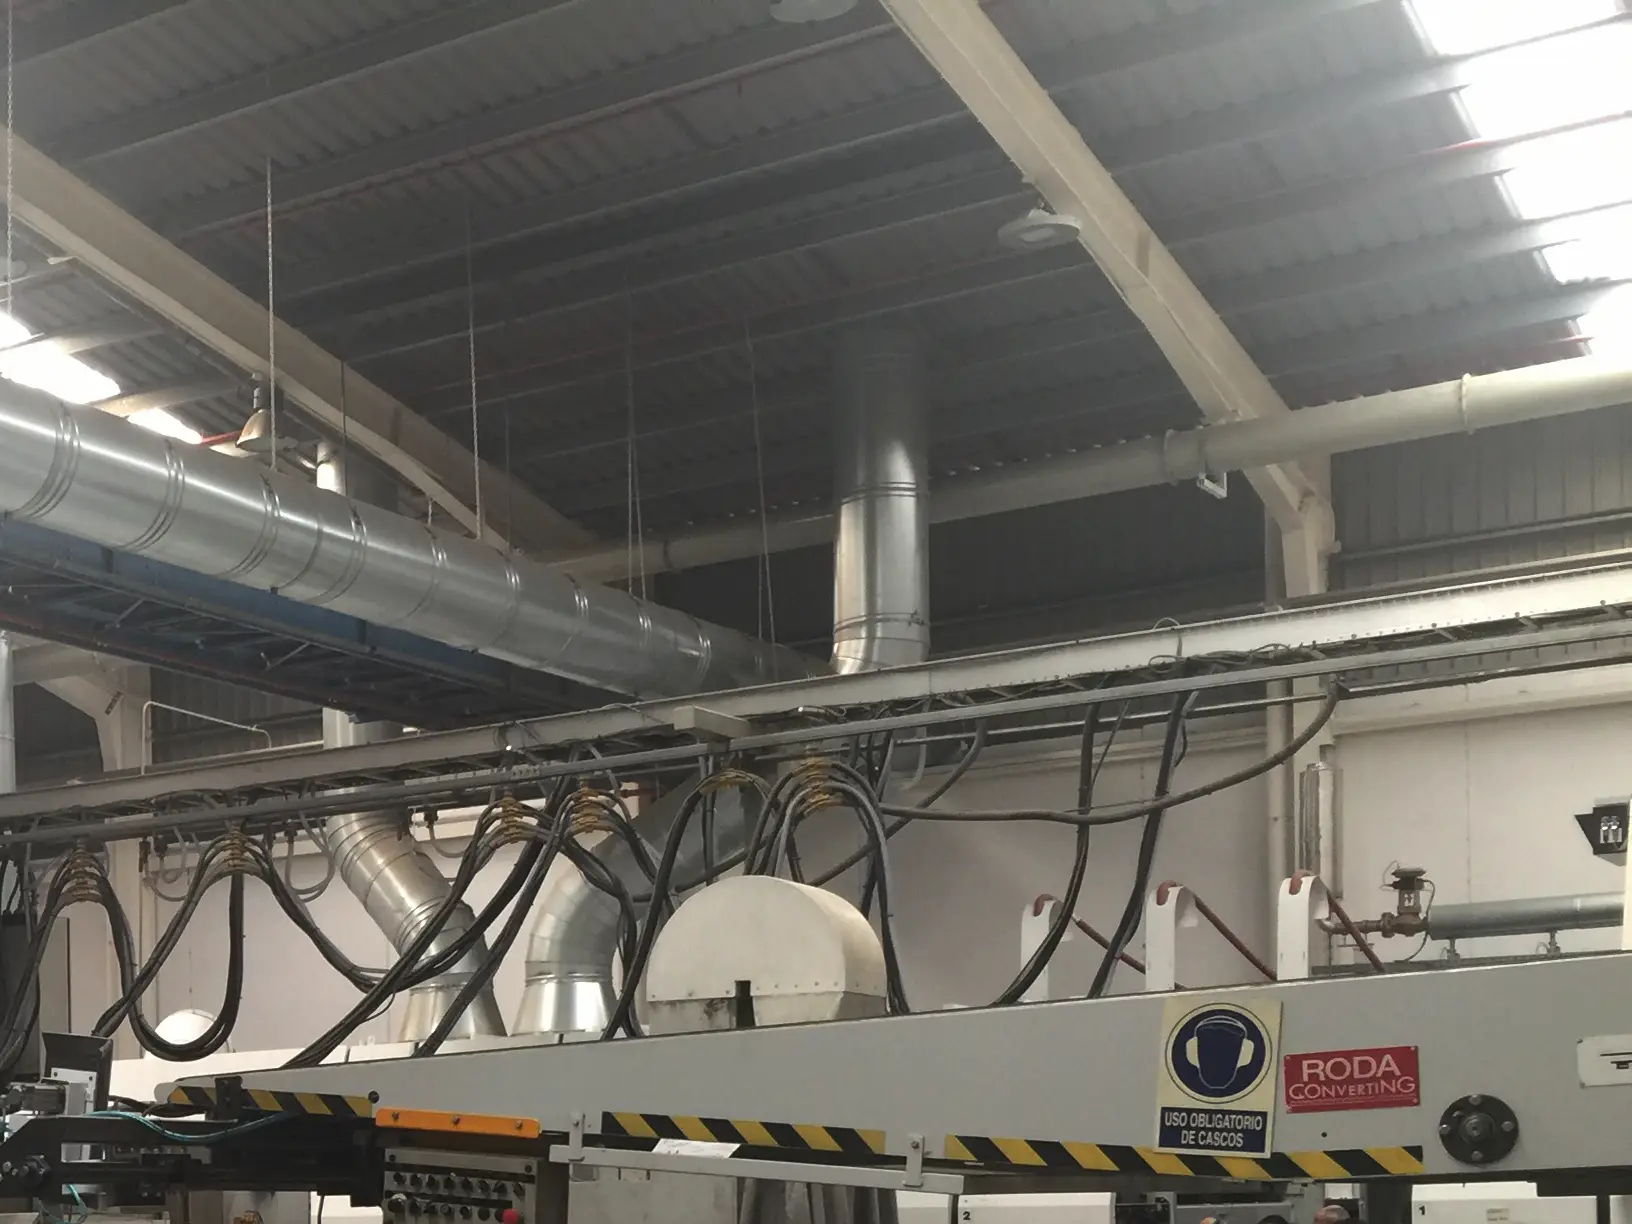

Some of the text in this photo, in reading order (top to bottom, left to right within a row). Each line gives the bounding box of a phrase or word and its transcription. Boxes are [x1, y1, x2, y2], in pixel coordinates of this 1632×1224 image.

[1301, 1054, 1401, 1082] RODA
[1289, 1076, 1416, 1100] CONVERTING
[1164, 1111, 1263, 1131] USO OBLIGATORIO
[1181, 1130, 1244, 1148] DE CASCOS
[963, 1211, 971, 1220] 2
[1419, 1205, 1426, 1215] 1
